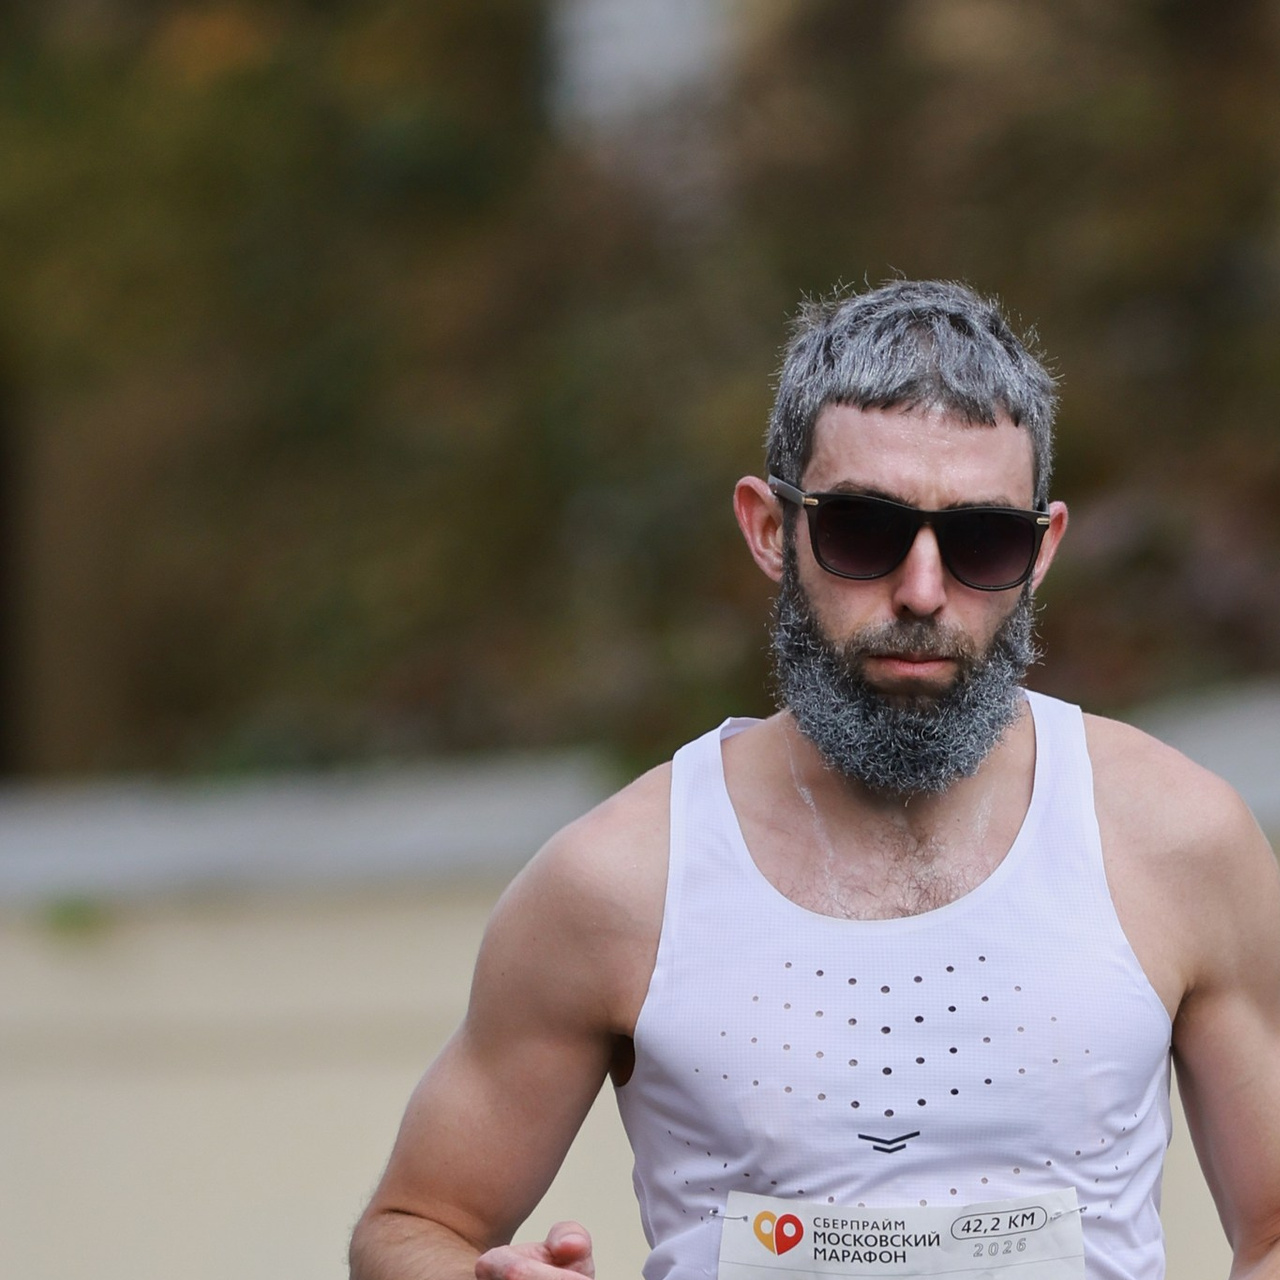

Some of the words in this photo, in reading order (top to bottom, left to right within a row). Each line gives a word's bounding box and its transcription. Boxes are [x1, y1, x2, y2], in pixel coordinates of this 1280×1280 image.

[813, 1216, 906, 1231] СБЕРПРАЙМ
[961, 1217, 1000, 1234] 42,2
[813, 1230, 941, 1248] МОСКОВСКИЙ
[973, 1237, 1027, 1258] 2026
[813, 1247, 907, 1264] МАРАФОН
